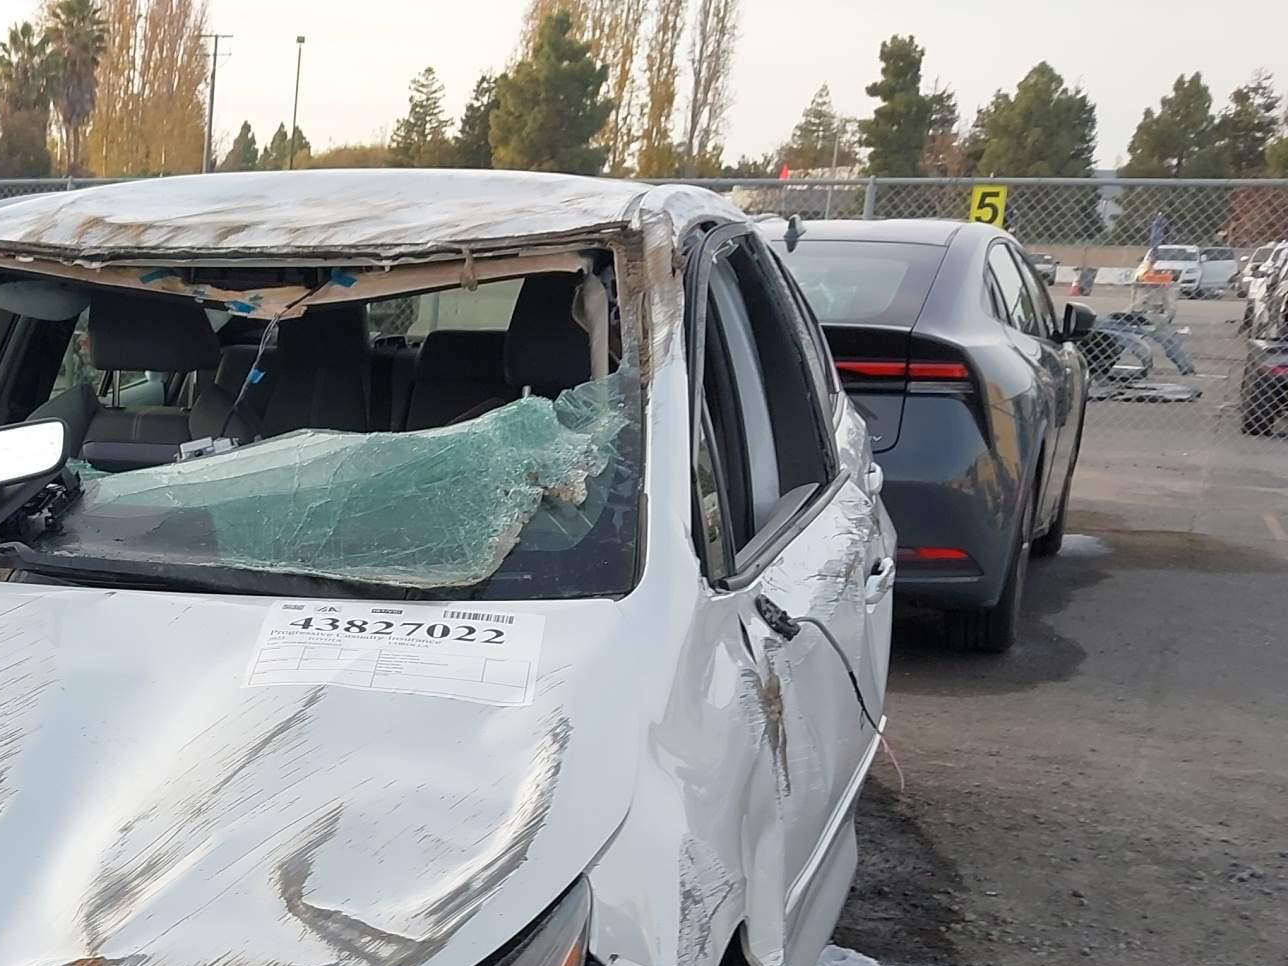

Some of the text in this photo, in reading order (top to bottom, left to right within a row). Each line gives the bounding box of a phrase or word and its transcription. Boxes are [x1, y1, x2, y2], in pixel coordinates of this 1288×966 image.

[975, 191, 1000, 223] 5
[270, 629, 333, 638] Progressive
[289, 616, 506, 645] 43827022
